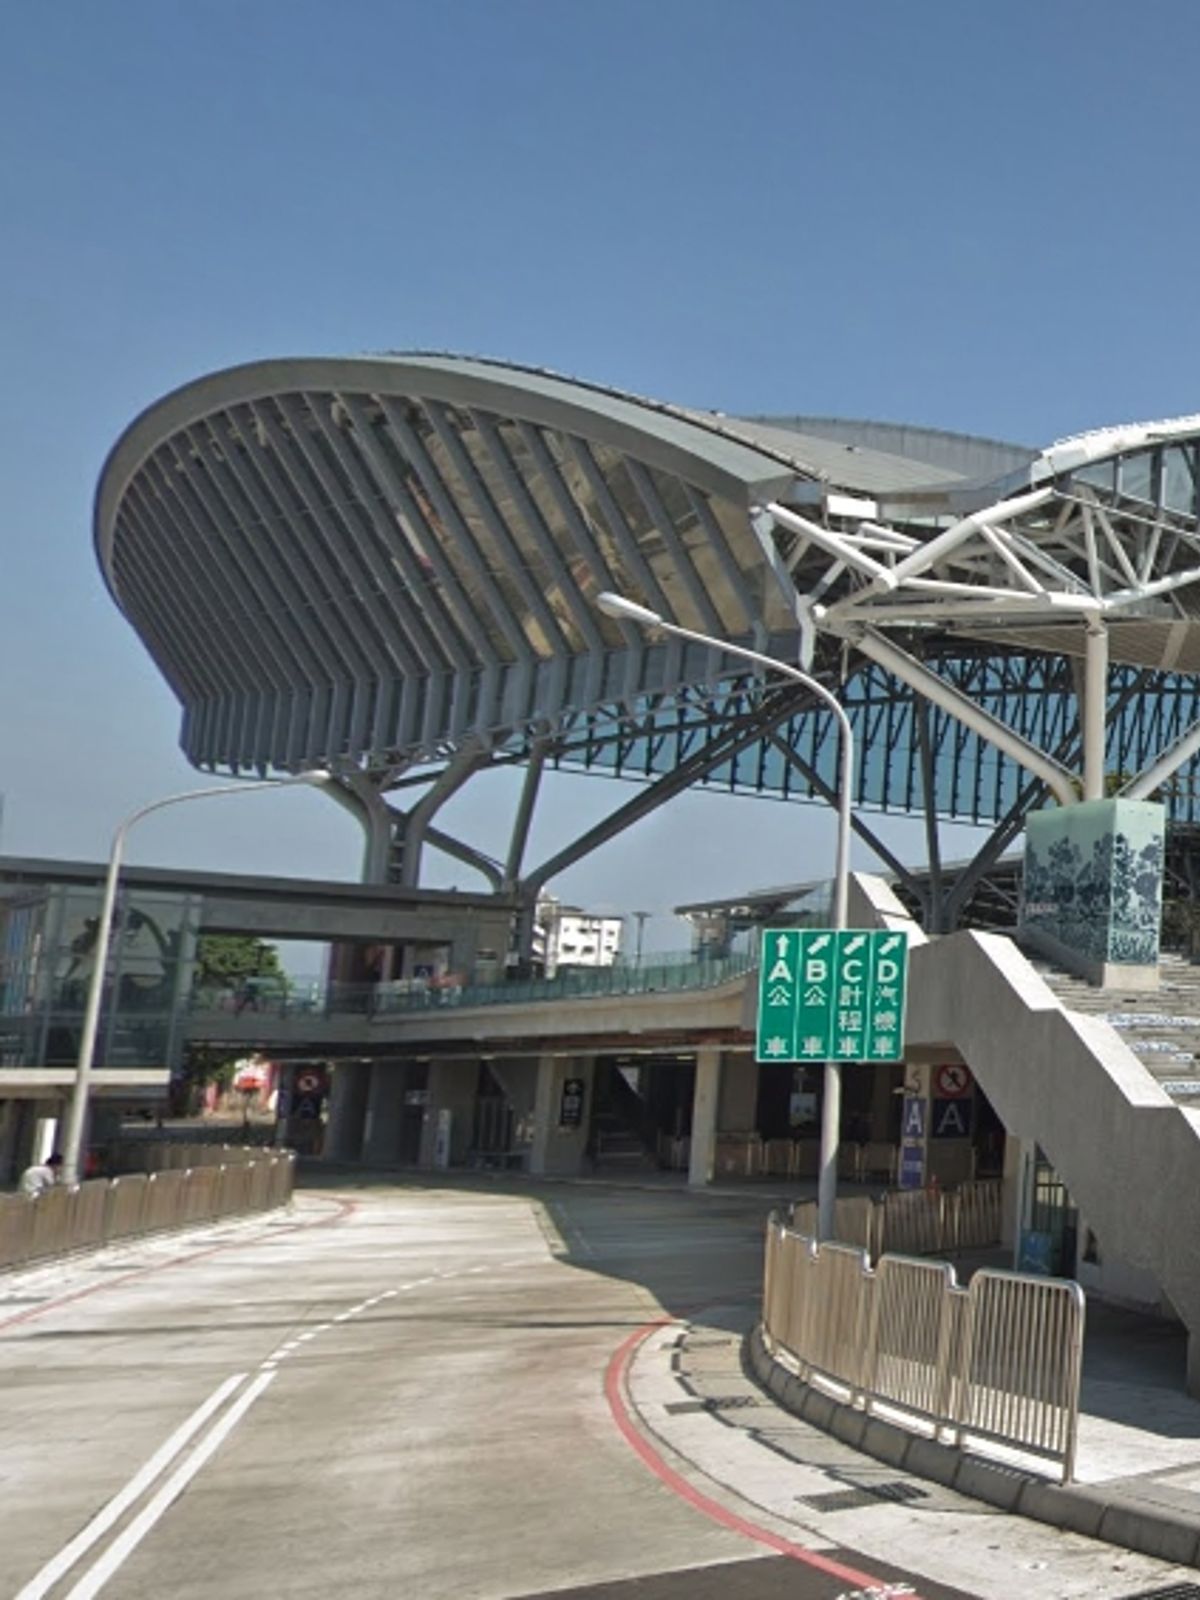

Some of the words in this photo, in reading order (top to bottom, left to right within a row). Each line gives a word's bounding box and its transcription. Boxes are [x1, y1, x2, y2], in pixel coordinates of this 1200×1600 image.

[767, 959, 793, 983] A
[806, 959, 827, 983] B
[842, 960, 863, 983] C
[877, 960, 898, 983] D
[906, 1101, 922, 1134] A
[936, 1102, 965, 1134] A
